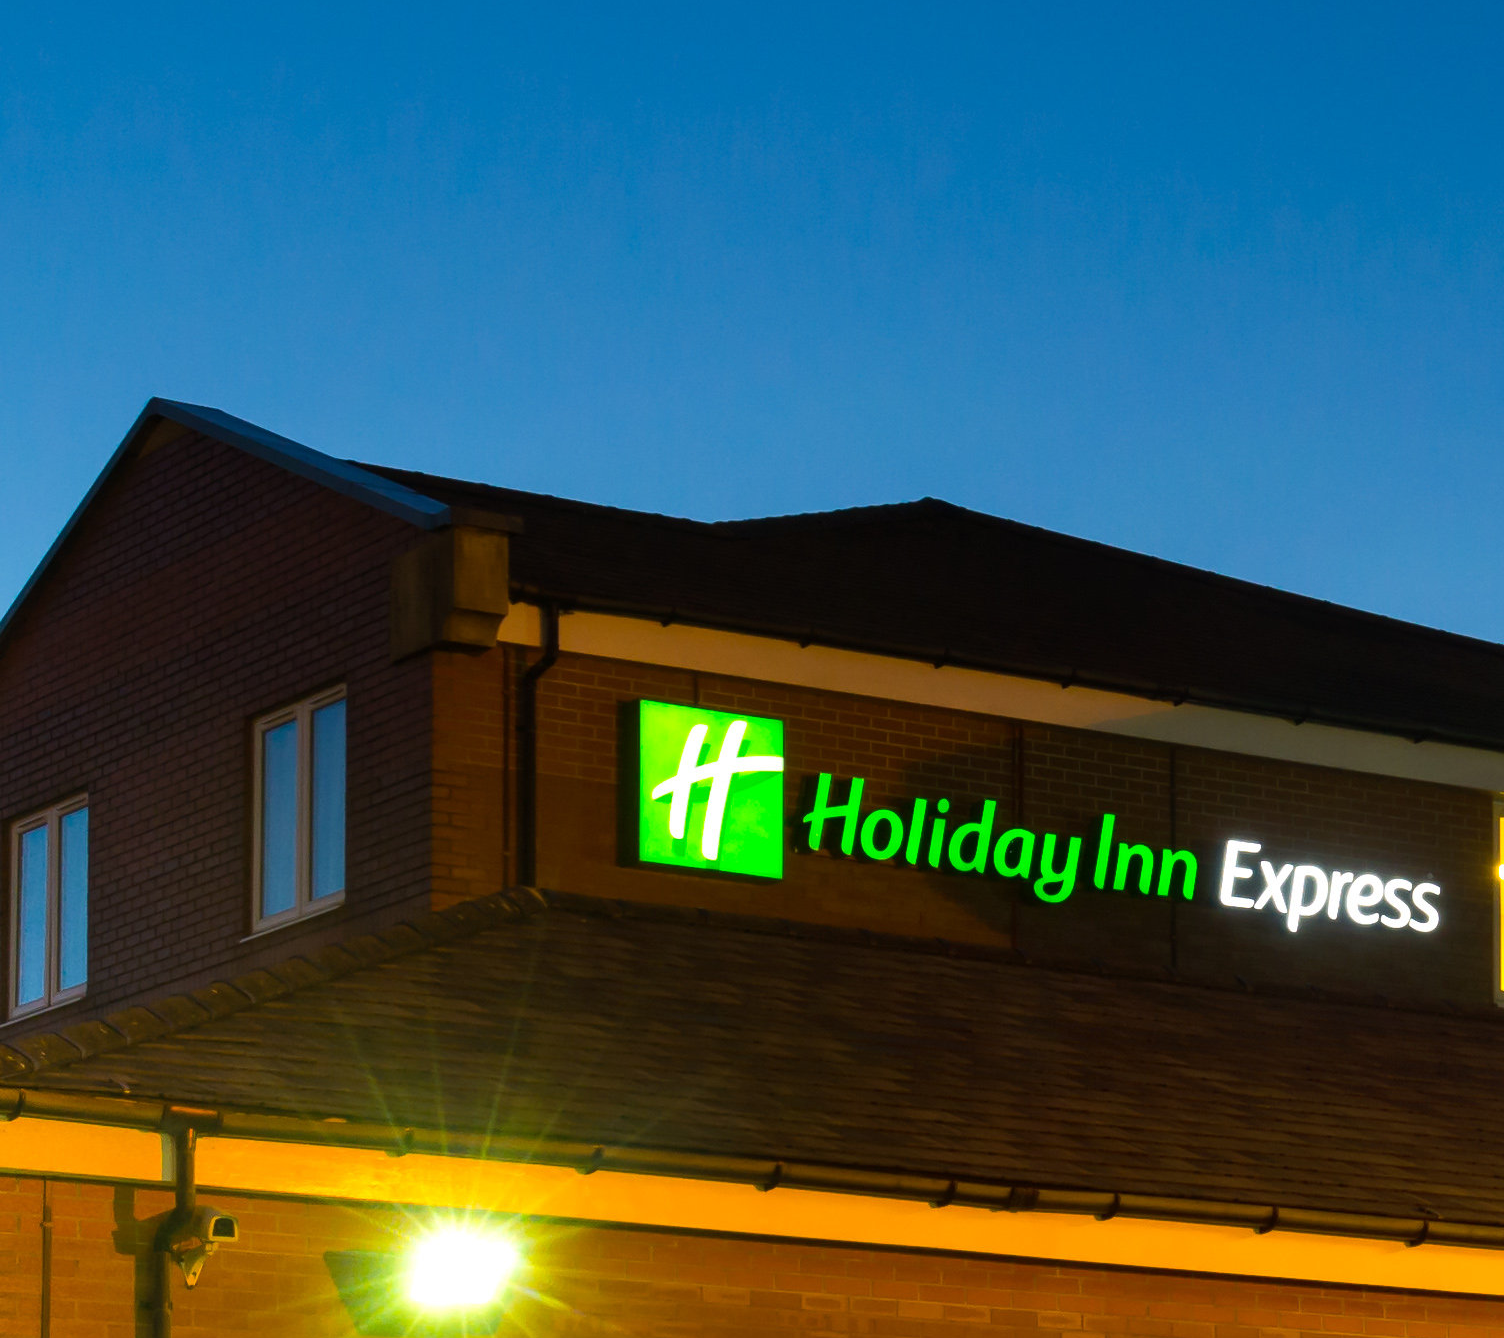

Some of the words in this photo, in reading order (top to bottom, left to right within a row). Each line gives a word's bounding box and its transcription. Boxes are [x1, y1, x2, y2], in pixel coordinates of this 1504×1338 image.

[802, 771, 1083, 904] Holiday
[1093, 813, 1198, 901] Inn
[1219, 838, 1442, 933] Express
